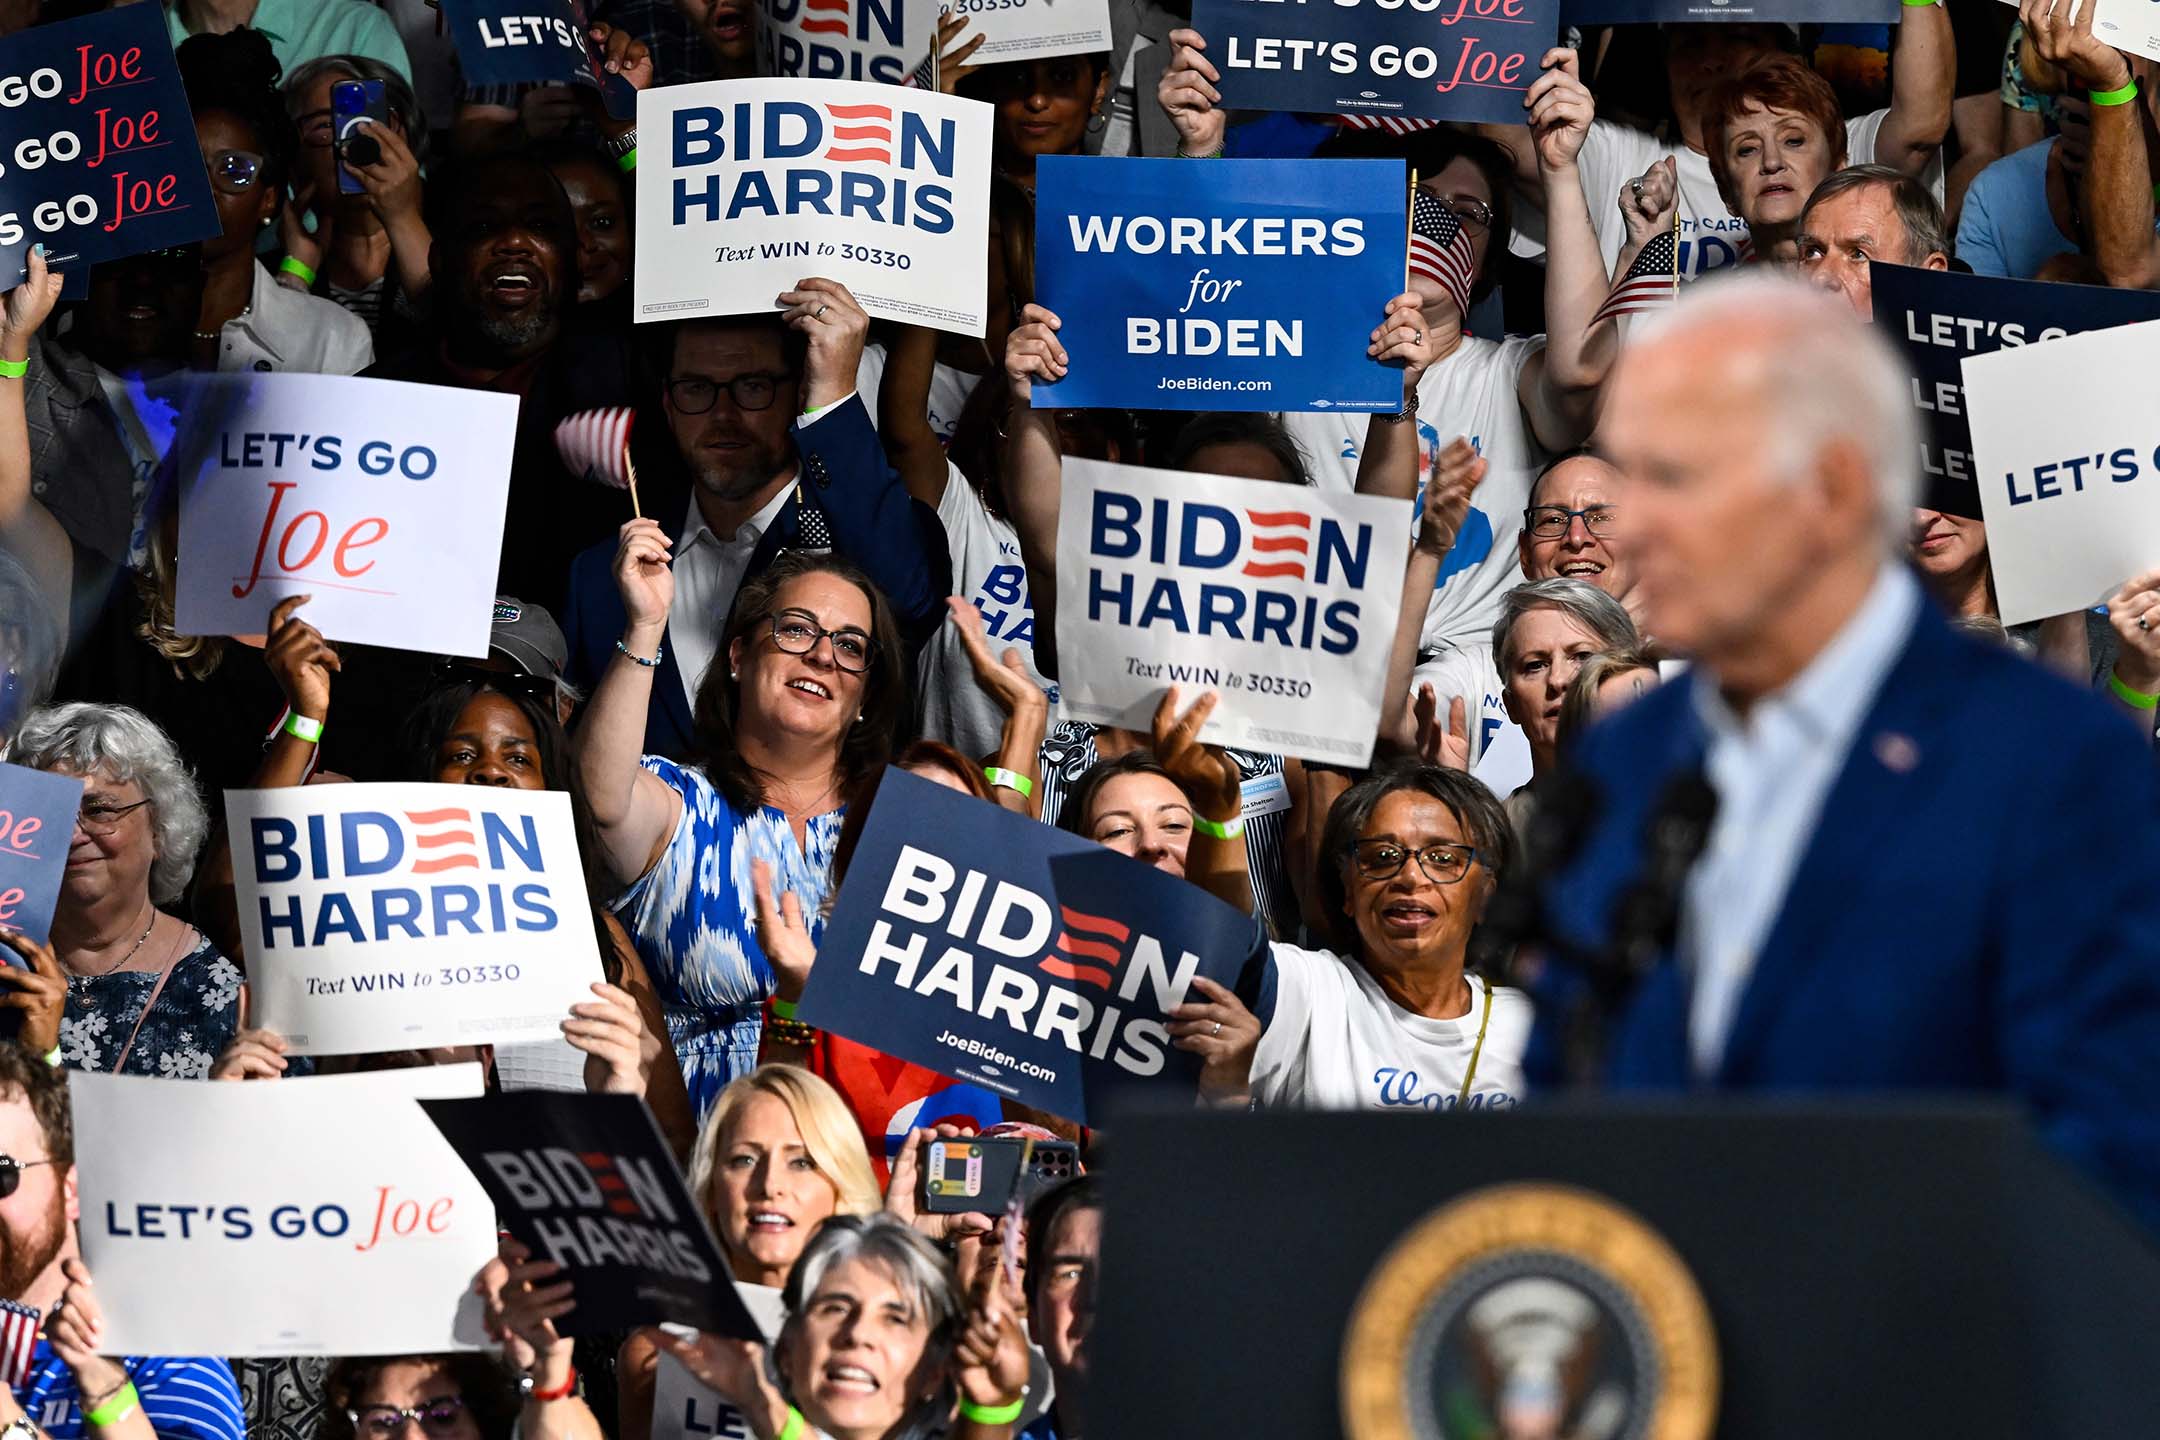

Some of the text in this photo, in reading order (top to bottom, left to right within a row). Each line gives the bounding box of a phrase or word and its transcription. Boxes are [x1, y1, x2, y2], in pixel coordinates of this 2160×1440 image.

[477, 16, 573, 48] LET'S
[0, 45, 142, 108] GO Joe
[1227, 37, 1526, 93] LET'S GO Joe
[14, 108, 160, 170] GO Joe
[672, 102, 957, 178] BIDEN
[33, 194, 99, 233] GO
[103, 171, 178, 232] Joe
[672, 169, 955, 234] HARRIS
[714, 241, 912, 270] Text WIN to 30330
[1068, 215, 1366, 256] WORKERS
[1179, 268, 1242, 313] for
[1127, 317, 1303, 357] BIDEN
[1906, 310, 2026, 351] LET'S
[1157, 377, 1273, 391] JoeBiden.com
[1911, 377, 1967, 415] LE
[220, 432, 437, 480] LET'S GO
[1920, 443, 1974, 481] LE
[2006, 448, 2140, 506] LET'S
[232, 481, 390, 599] Joe
[1090, 489, 1373, 590] BIDEN
[1088, 568, 1362, 656] HARRIS
[1125, 656, 1312, 699] Text WIN to 30330
[251, 808, 545, 884] BIDEN
[259, 884, 559, 949] HARRIS
[881, 844, 1200, 1015] BIDEN
[306, 963, 521, 996] Text WIN to 30330
[859, 919, 1171, 1077] HARRIS
[936, 1029, 1057, 1084] JoeBiden.com
[477, 1148, 680, 1223] BIDEN
[106, 1185, 455, 1252] LET'S GO Joe
[532, 1215, 712, 1283] HARRIS
